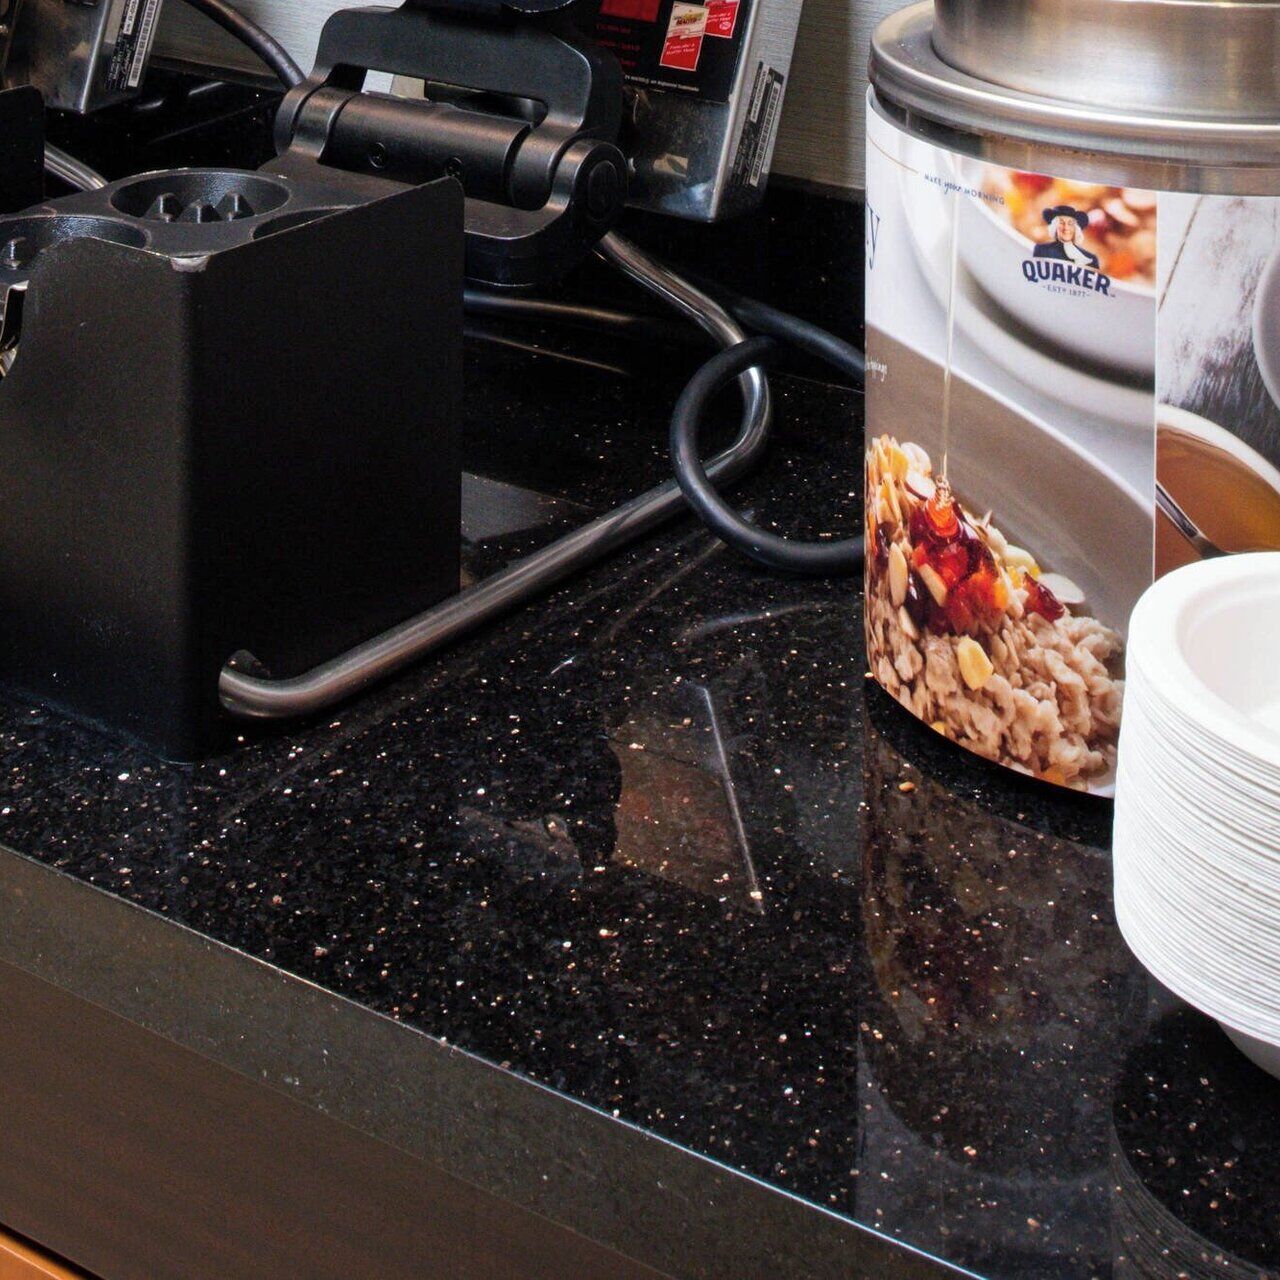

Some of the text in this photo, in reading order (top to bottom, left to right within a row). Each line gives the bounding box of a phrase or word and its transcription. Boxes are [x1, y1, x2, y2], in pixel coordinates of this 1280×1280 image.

[924, 173, 1005, 205] MAKE your MORNING
[1022, 260, 1111, 296] QUAKER
[1069, 289, 1086, 298] 1877
